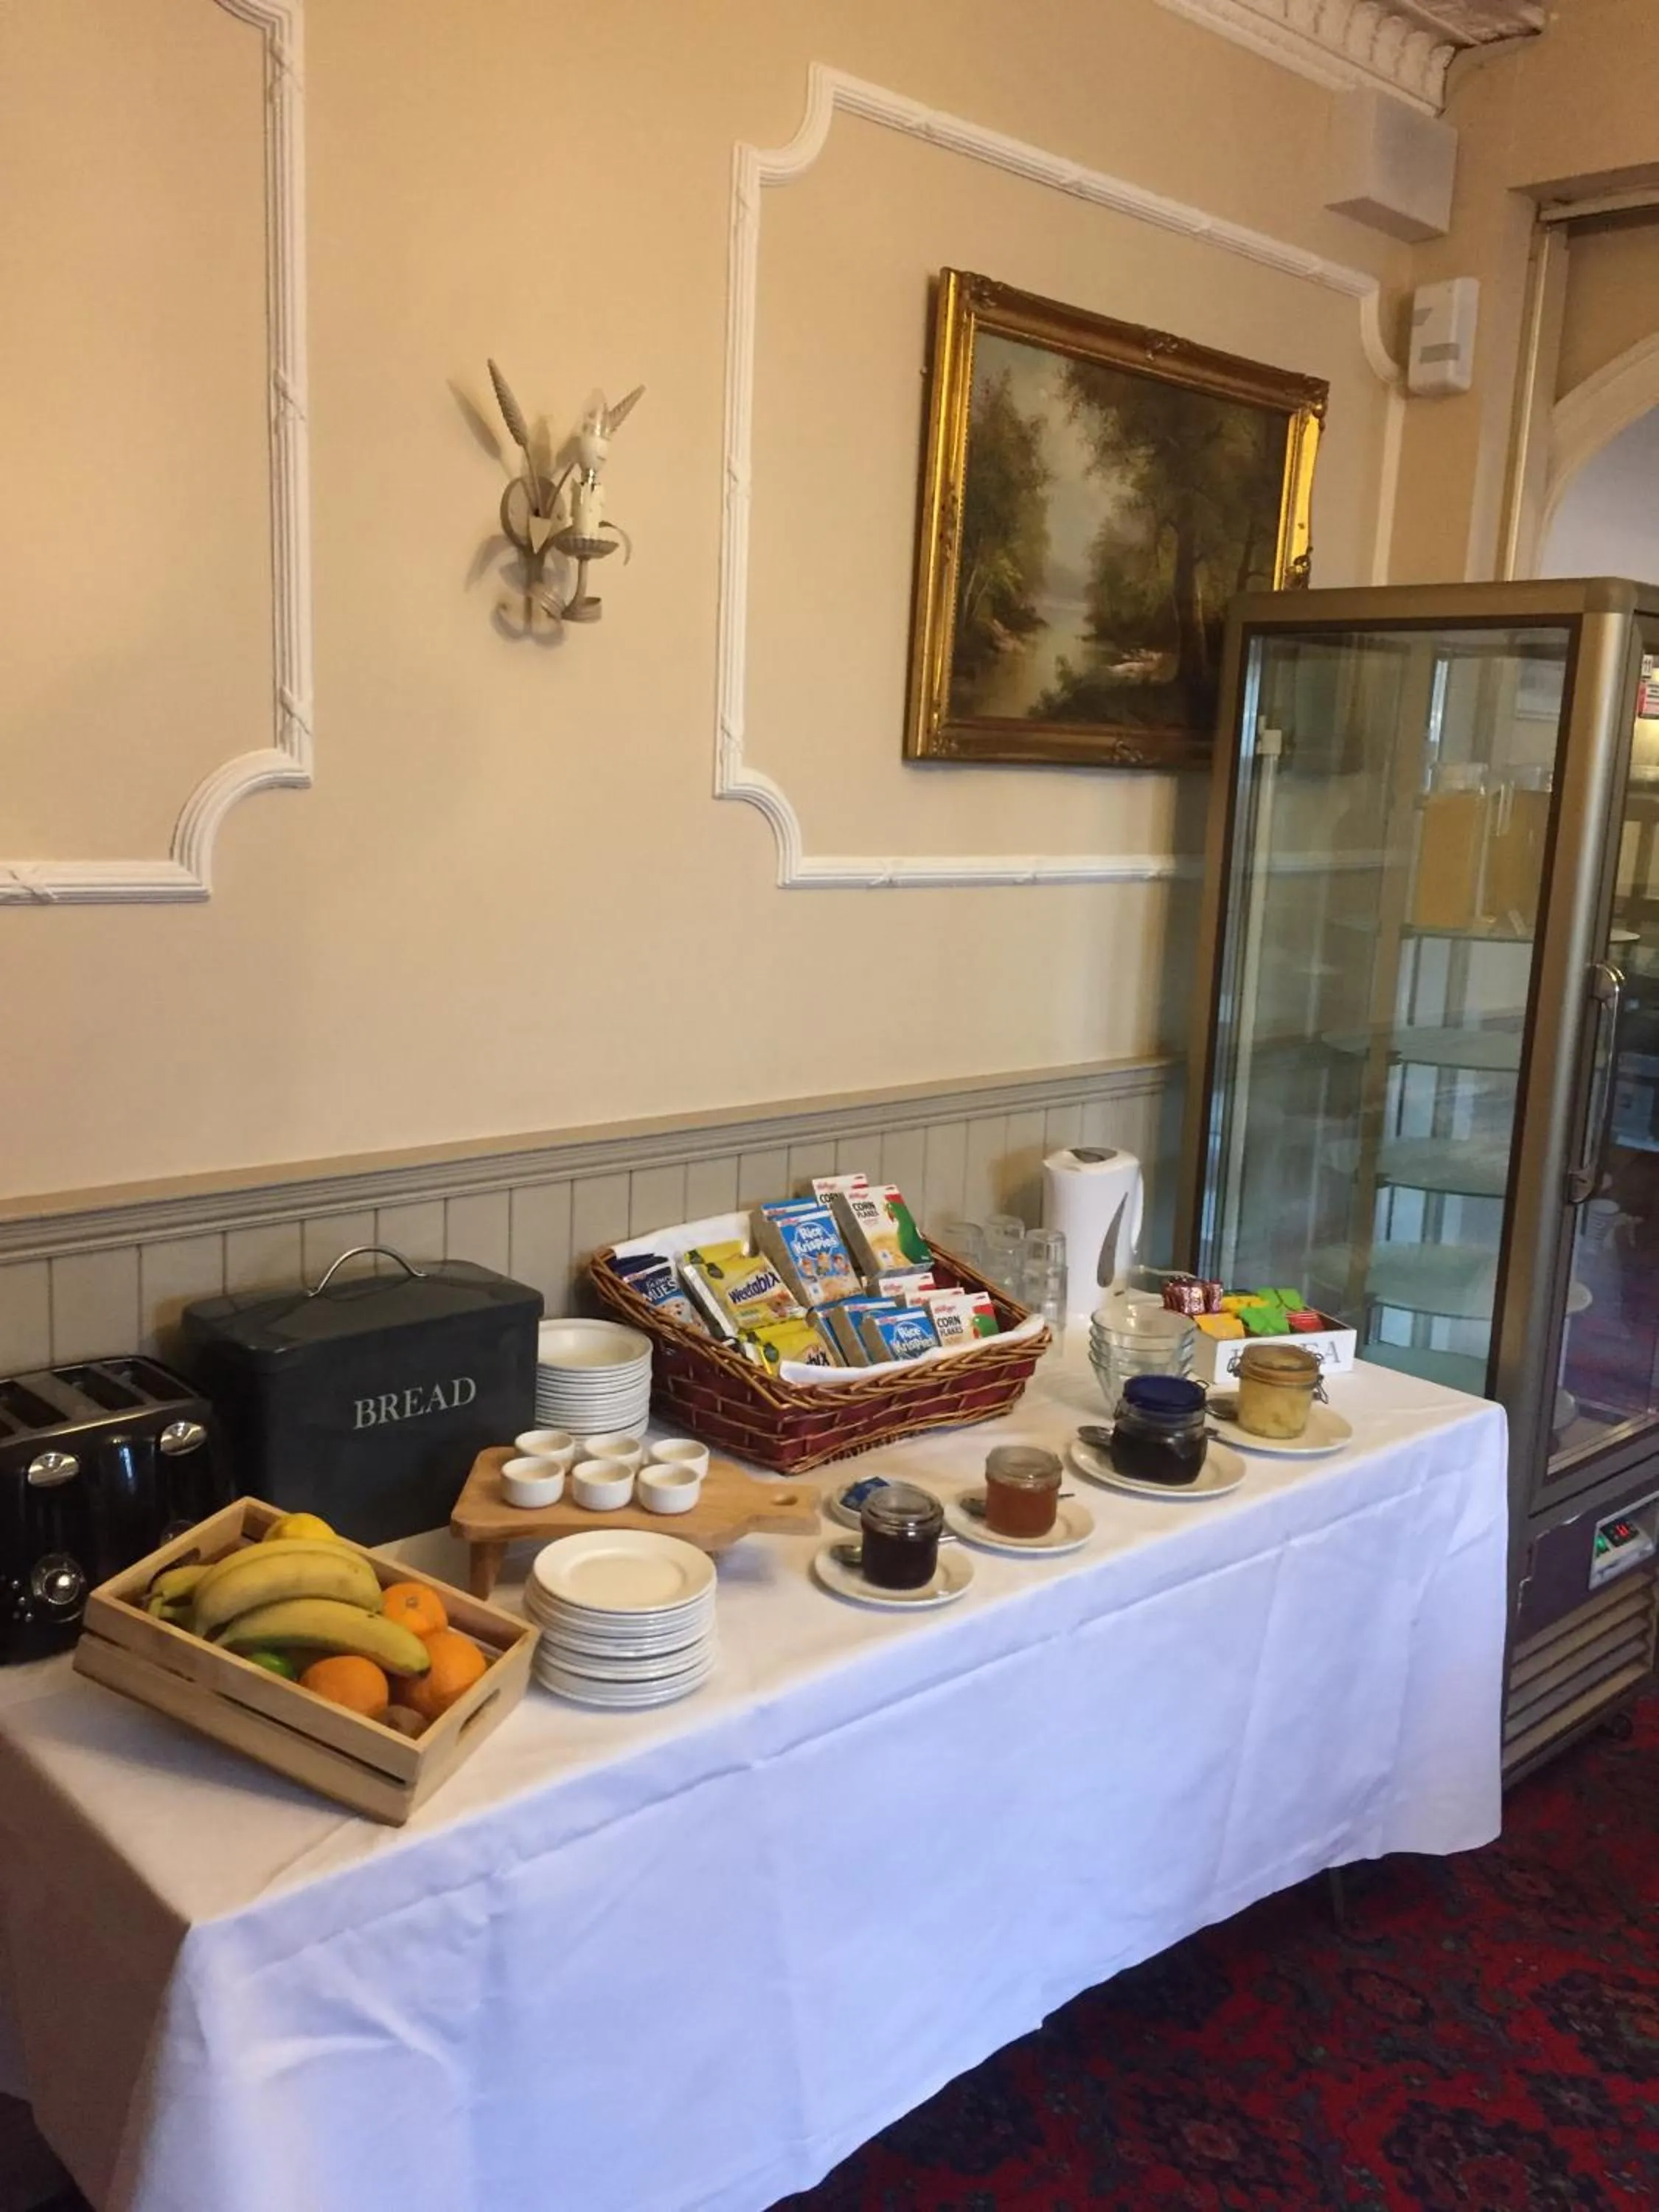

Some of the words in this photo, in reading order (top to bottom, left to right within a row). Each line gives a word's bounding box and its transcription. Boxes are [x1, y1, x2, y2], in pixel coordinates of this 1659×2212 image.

[852, 1201, 877, 1212] CORN
[798, 1225, 823, 1240] Rice
[792, 1234, 839, 1254] Krispies
[728, 1271, 781, 1304] Weetabix
[936, 1315, 961, 1328] CORN
[897, 1326, 922, 1340] Rice
[939, 1326, 964, 1337] FLAKES
[891, 1336, 939, 1354] Krispies
[353, 1376, 477, 1430] BREAD
